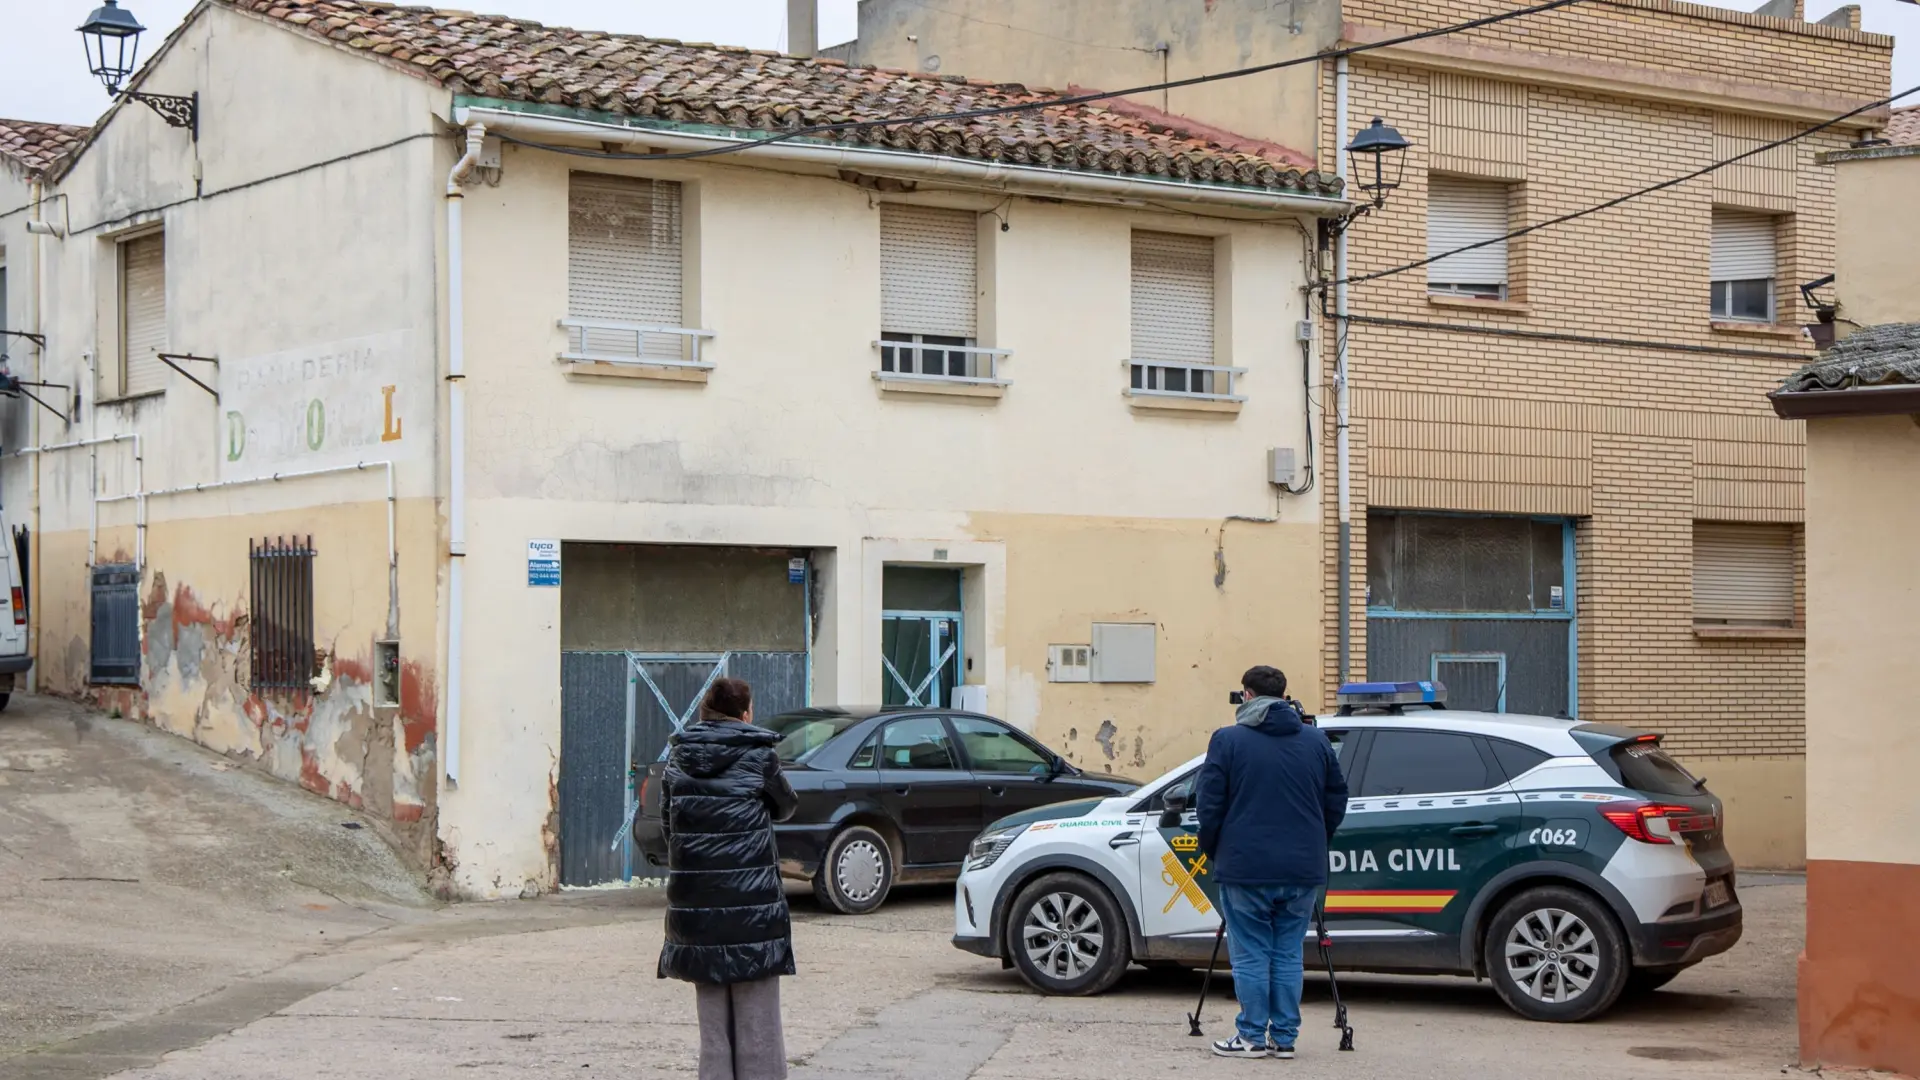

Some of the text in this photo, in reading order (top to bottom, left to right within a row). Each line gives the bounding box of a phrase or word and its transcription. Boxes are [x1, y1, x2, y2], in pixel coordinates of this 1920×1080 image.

[530, 542, 553, 551] tyco
[1059, 820, 1098, 828] GUARDIA
[1541, 828, 1576, 845] 062
[1388, 848, 1461, 871] CIVIL
